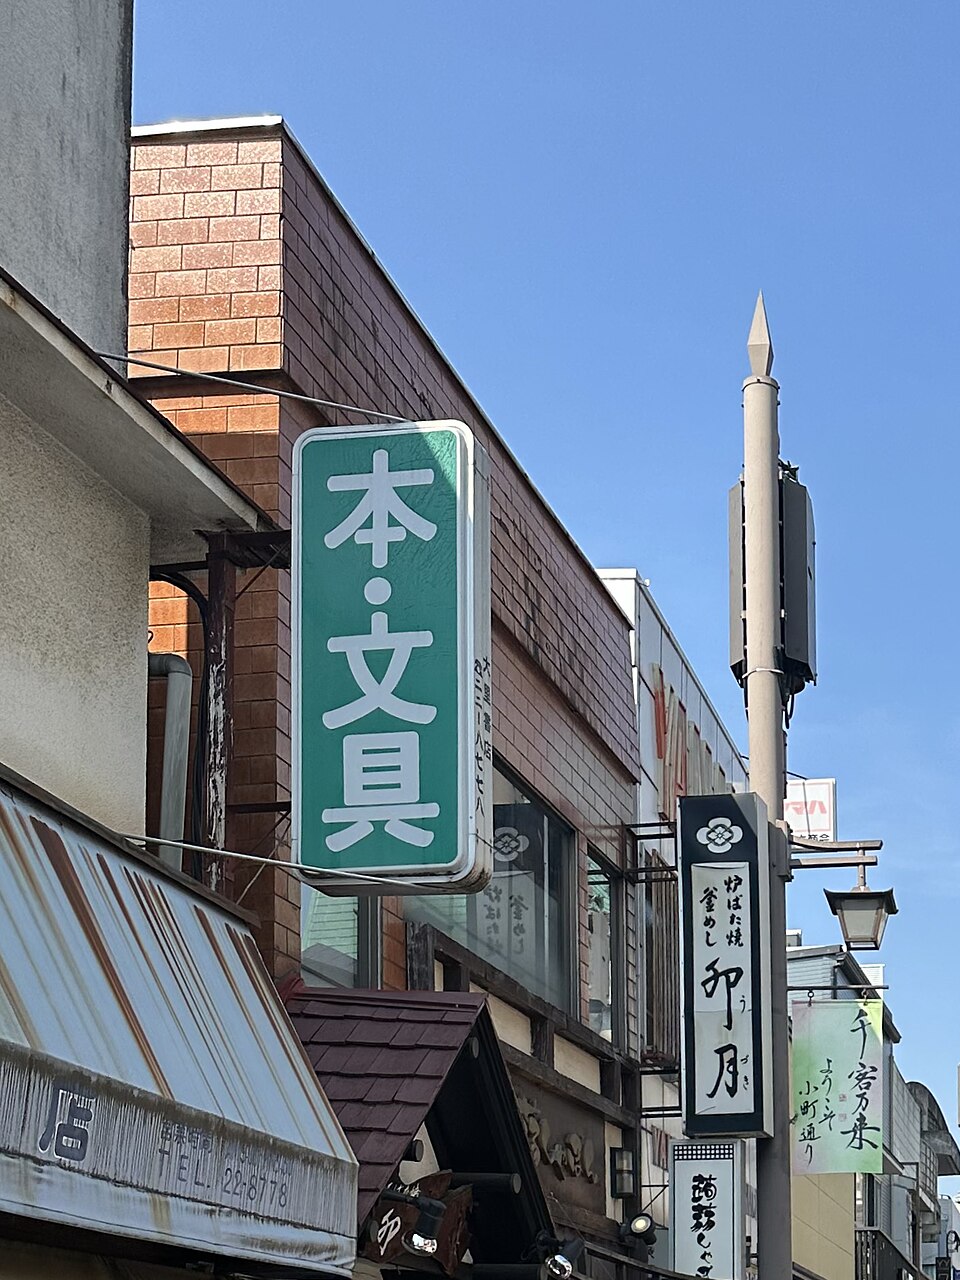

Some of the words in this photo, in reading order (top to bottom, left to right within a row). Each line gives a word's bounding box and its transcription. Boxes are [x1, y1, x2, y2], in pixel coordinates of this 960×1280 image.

[322, 449, 440, 853] 本・文具
[700, 887, 718, 947] 釜めし
[724, 875, 744, 947] 炉ばた焼
[701, 957, 743, 1098] 卯月
[819, 1058, 836, 1131] ようこそ
[841, 1009, 880, 1151] 千客万来
[799, 1081, 821, 1168] 小町通り
[223, 1167, 288, 1208] 22-8778
